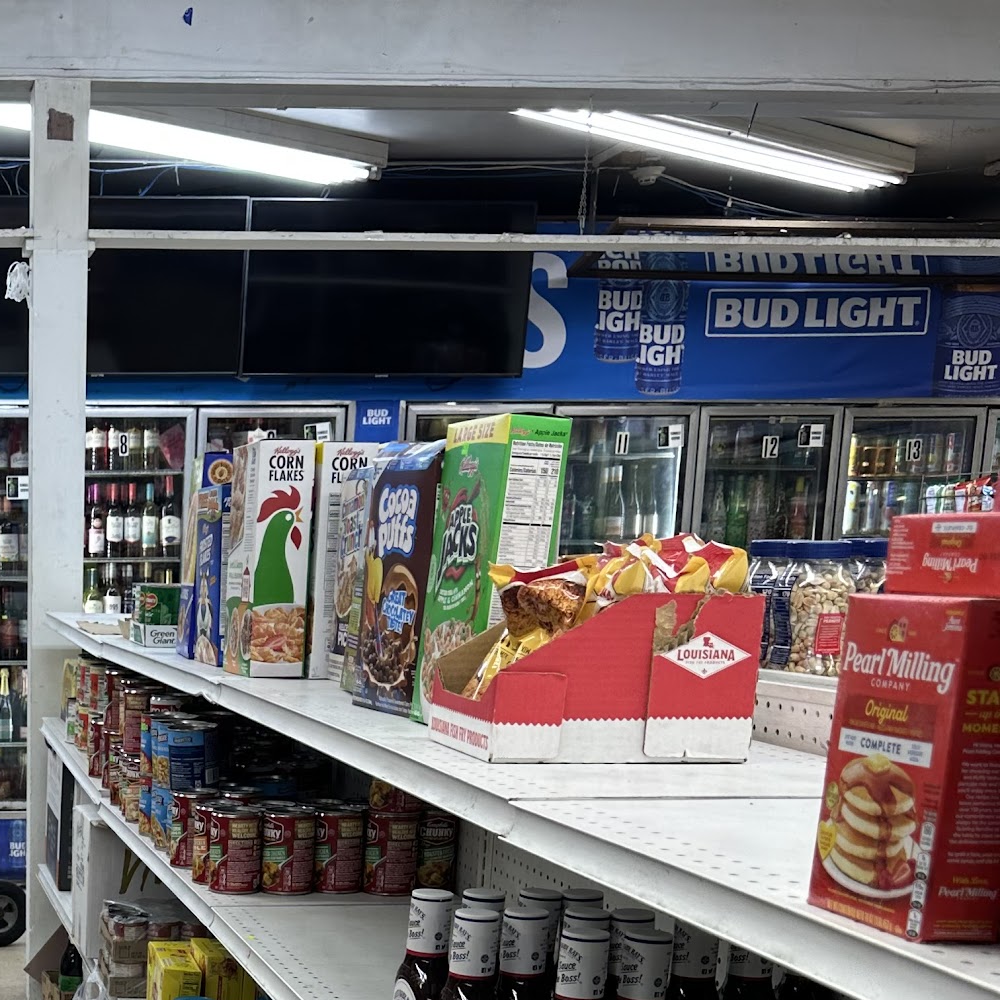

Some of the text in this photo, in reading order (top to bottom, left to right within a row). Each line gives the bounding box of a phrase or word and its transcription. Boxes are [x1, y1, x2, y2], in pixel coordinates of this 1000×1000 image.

[598, 290, 642, 311] BUD
[715, 296, 922, 329] BUD LIGHT
[639, 324, 685, 345] BUD
[951, 349, 991, 366] BUD
[944, 364, 998, 382] LIGHT
[362, 416, 392, 426] LIGHT
[367, 409, 389, 418] BUD
[453, 421, 494, 444] LARGE SIZE
[119, 434, 128, 455] 8
[618, 434, 628, 454] 11
[764, 437, 777, 457] 12
[907, 440, 921, 460] 13
[269, 455, 304, 470] CORN
[331, 457, 368, 472] CORN
[269, 469, 304, 482] FLAKES
[378, 485, 418, 524] Cocoa
[151, 630, 175, 639] Green
[153, 636, 176, 645] Giant
[677, 647, 736, 662] LOUISIANA
[843, 642, 956, 695] Pearl Milling
[870, 678, 911, 691] COMPANY
[864, 699, 909, 724] Original
[860, 737, 902, 755] COMPLETE
